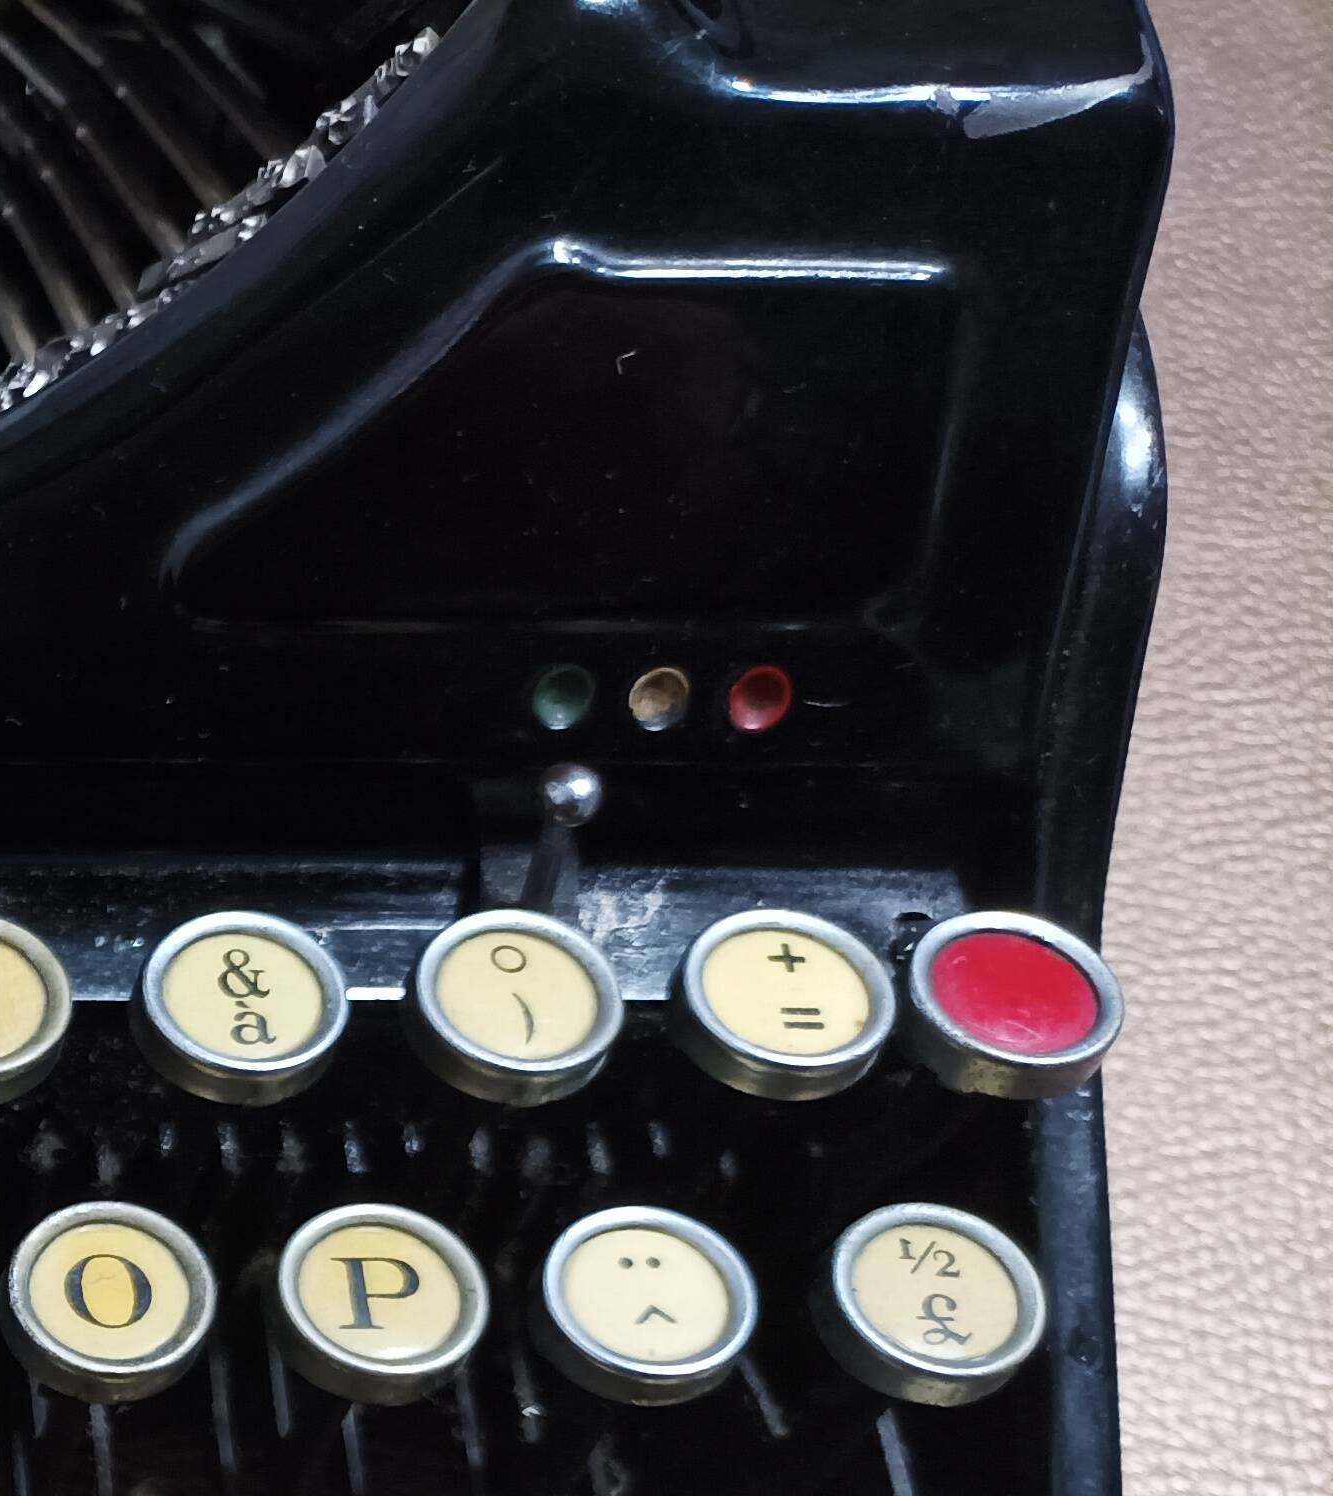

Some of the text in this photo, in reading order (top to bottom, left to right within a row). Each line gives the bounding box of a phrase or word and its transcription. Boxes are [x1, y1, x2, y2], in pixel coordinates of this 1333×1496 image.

[218, 949, 270, 998] &
[231, 1001, 276, 1045] à
[64, 1254, 152, 1328] O
[331, 1257, 420, 1329] P
